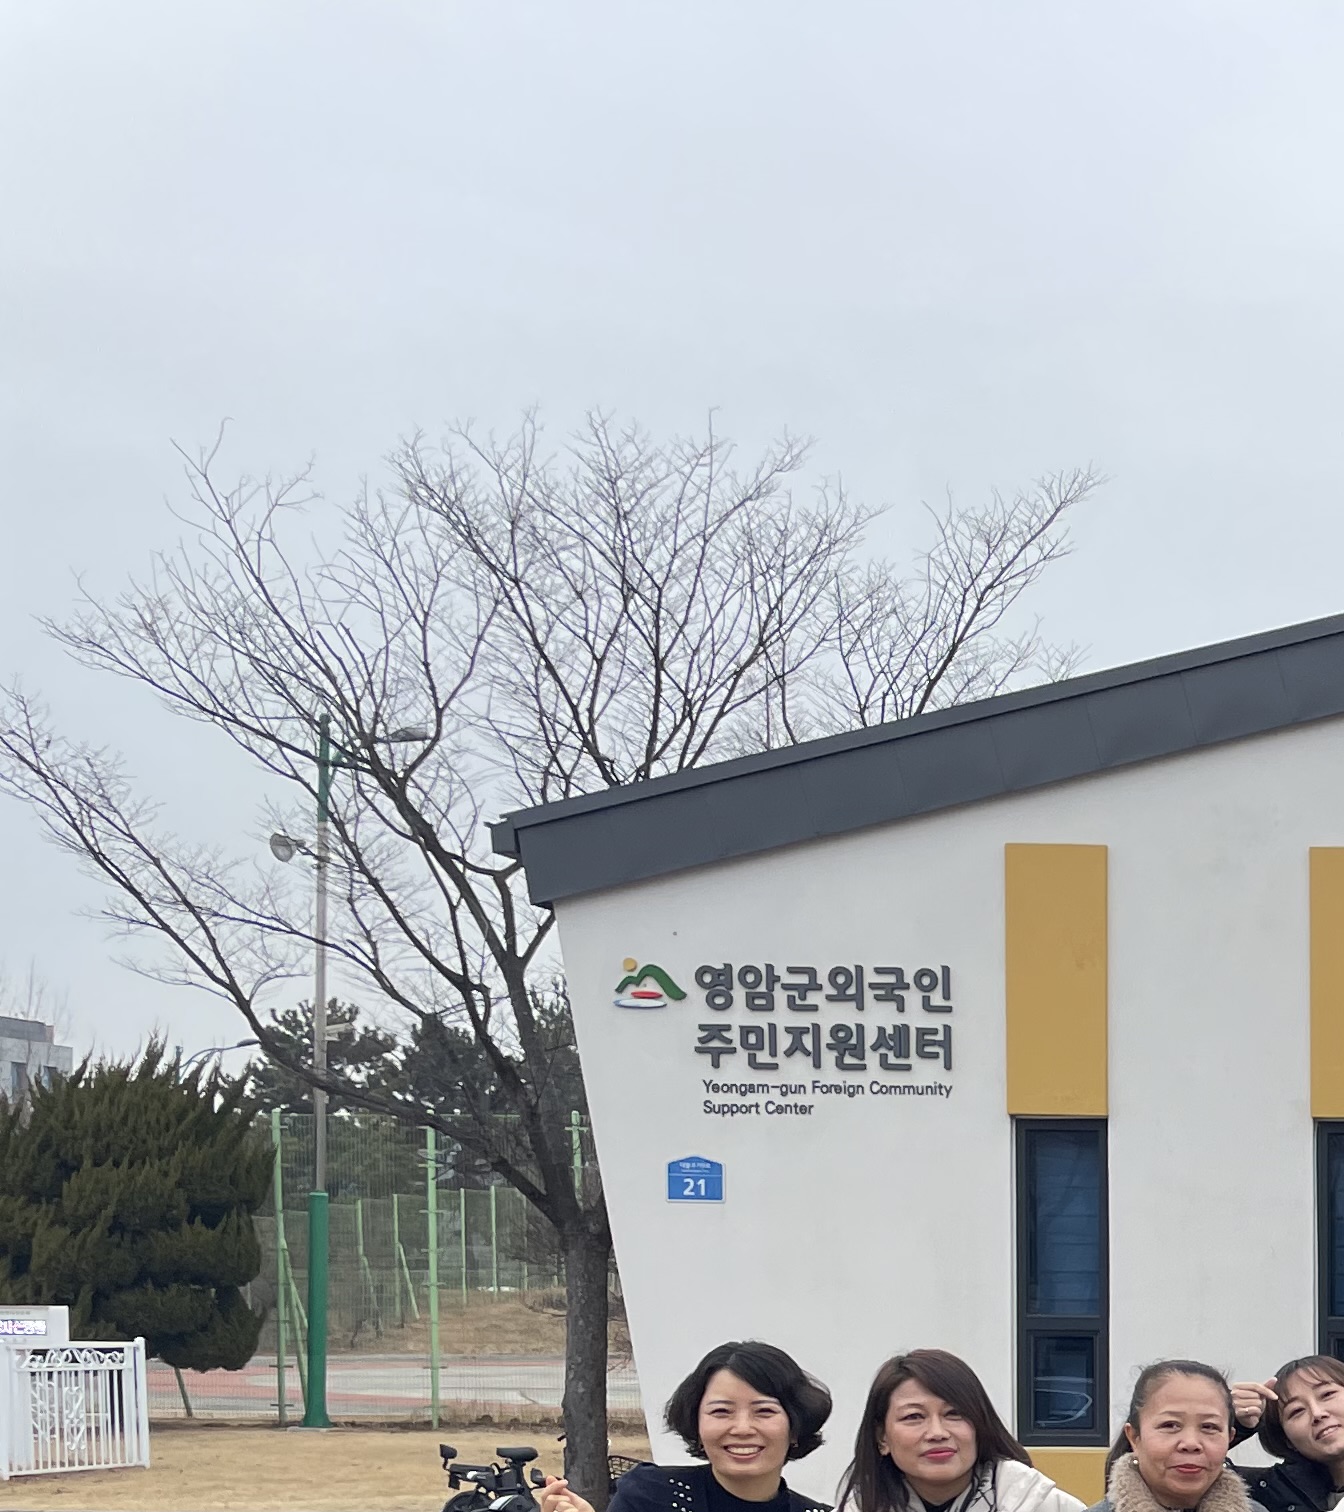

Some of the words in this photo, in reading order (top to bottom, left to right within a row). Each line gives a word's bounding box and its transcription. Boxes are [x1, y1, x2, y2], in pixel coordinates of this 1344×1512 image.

[694, 962, 953, 1014] 영암군외국인
[694, 1022, 953, 1072] 주민지원센터
[702, 1079, 807, 1098] Yeongam-gun
[811, 1079, 865, 1098] Foreign
[869, 1080, 953, 1099] Community
[703, 1099, 761, 1116] Support
[764, 1100, 815, 1115] Center
[683, 1177, 706, 1196] 21
